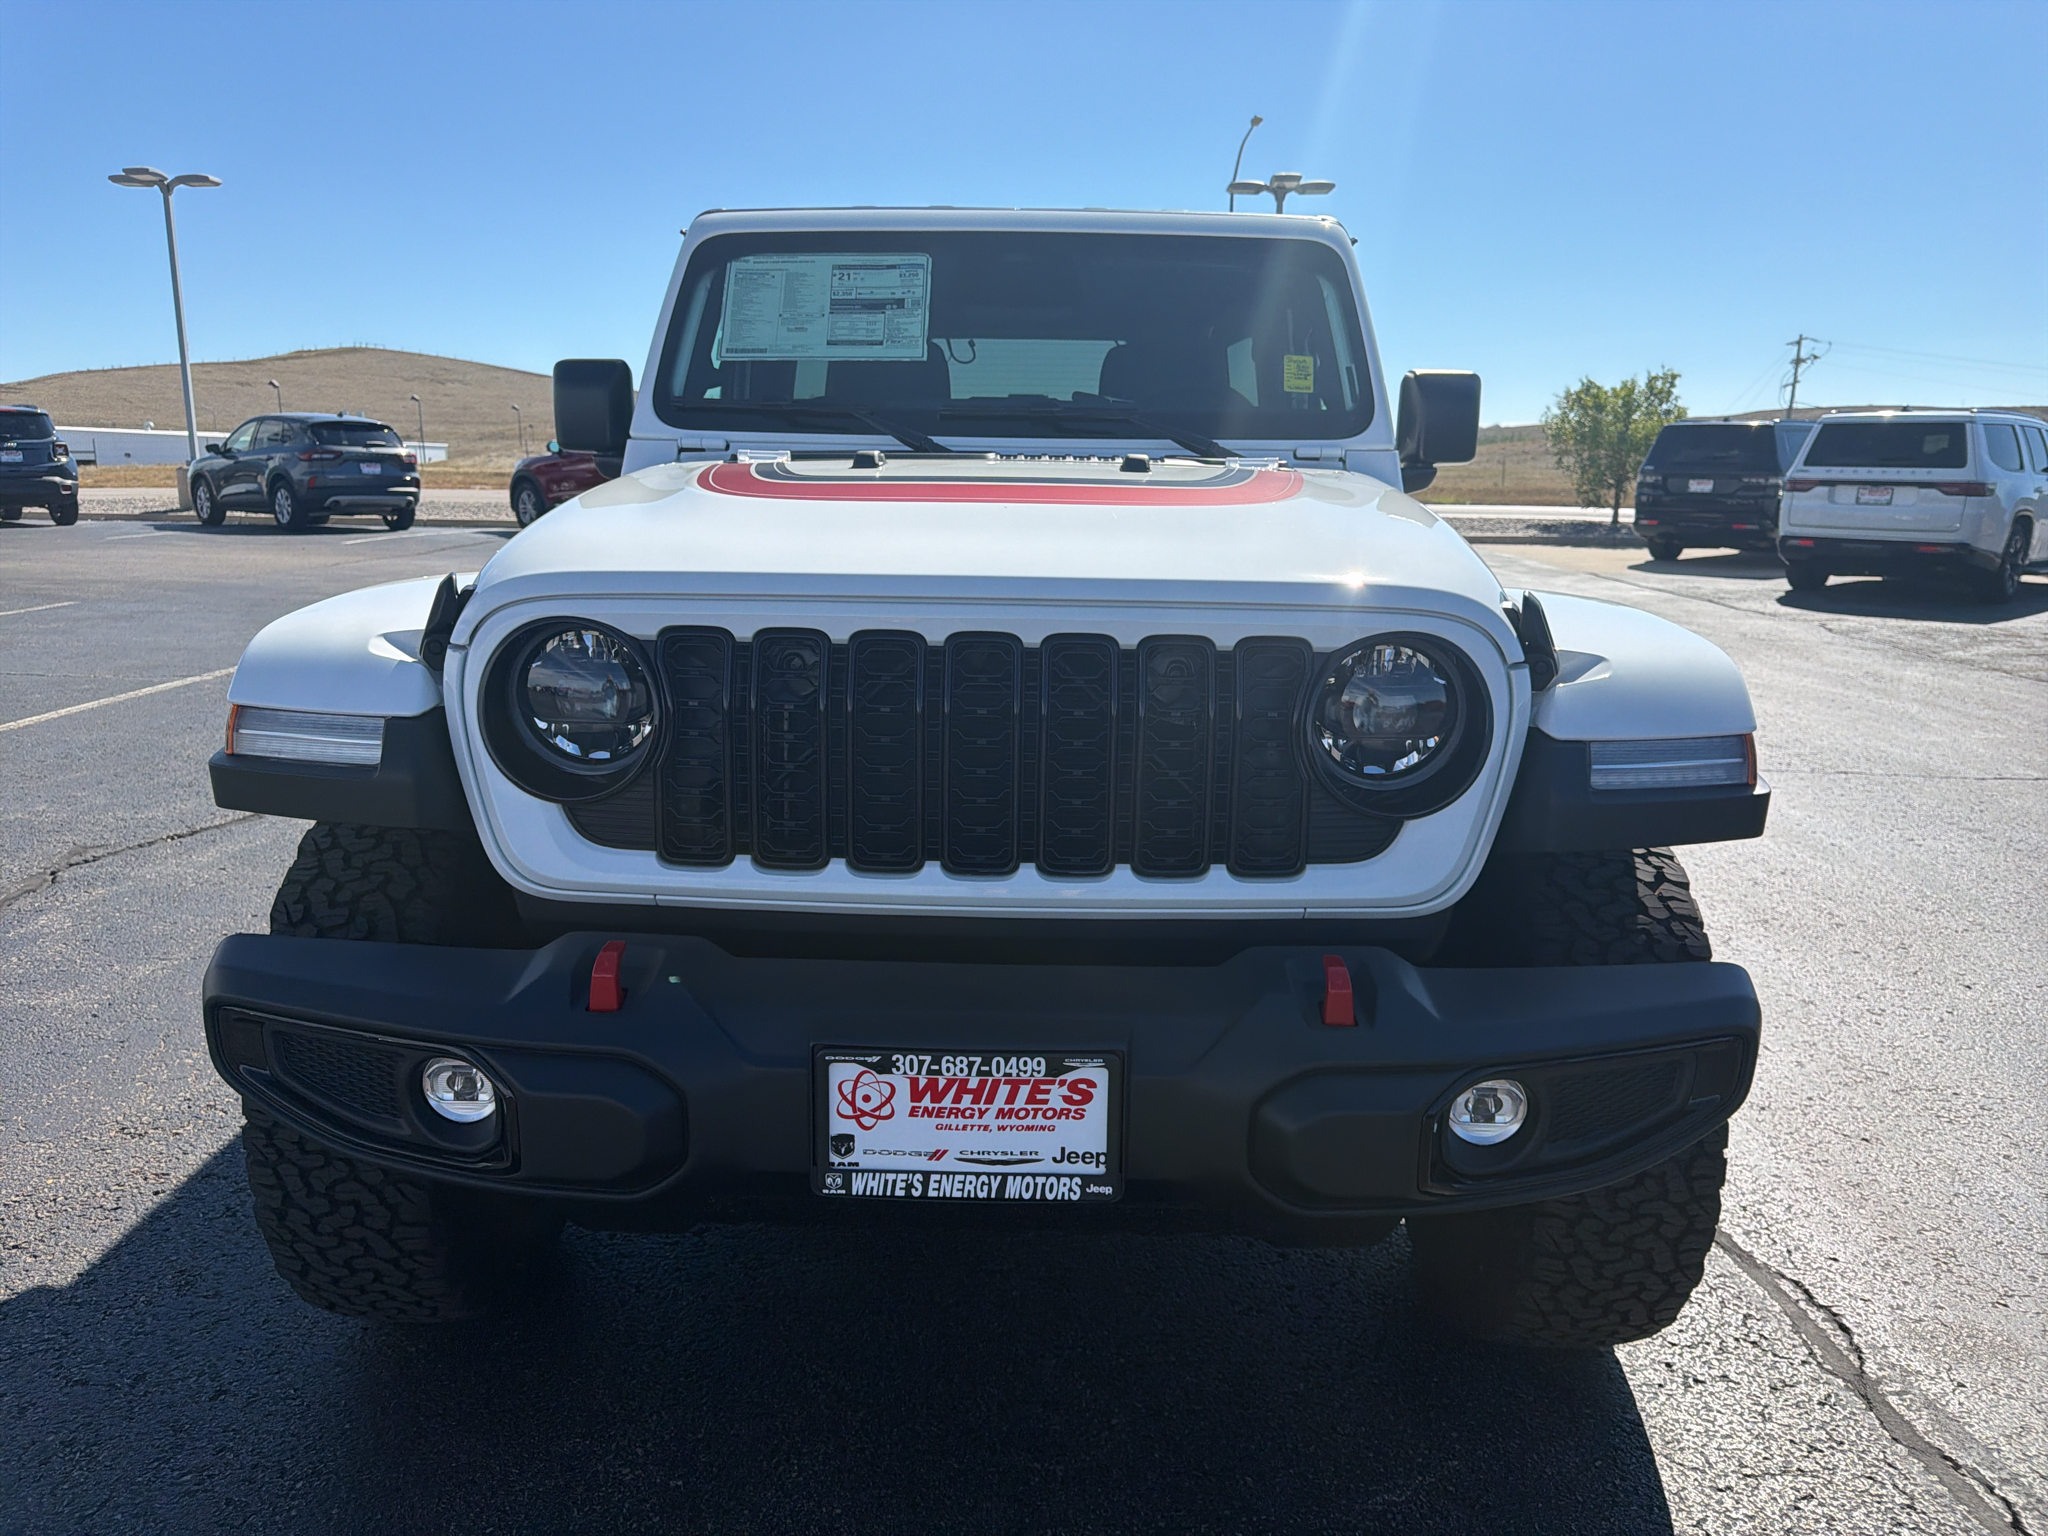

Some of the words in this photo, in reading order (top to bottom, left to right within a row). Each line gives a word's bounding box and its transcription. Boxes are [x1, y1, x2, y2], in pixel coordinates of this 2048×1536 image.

[838, 272, 851, 281] 21
[891, 1054, 1046, 1077] 307-687-0499
[903, 1076, 1097, 1107] WHITE'S
[908, 1105, 985, 1120] ENERGY
[995, 1106, 1086, 1121] MOTORS
[935, 1123, 992, 1134] GILLETTE,
[997, 1124, 1056, 1133] WYOMING
[862, 1148, 937, 1158] DODGE
[959, 1149, 1040, 1157] CHRYSLER
[1051, 1146, 1107, 1169] Jeep
[851, 1172, 923, 1198] WHITE'S
[927, 1175, 1000, 1199] ENERGY
[1004, 1175, 1082, 1201] MOTORS
[1085, 1183, 1113, 1195] Jeep
